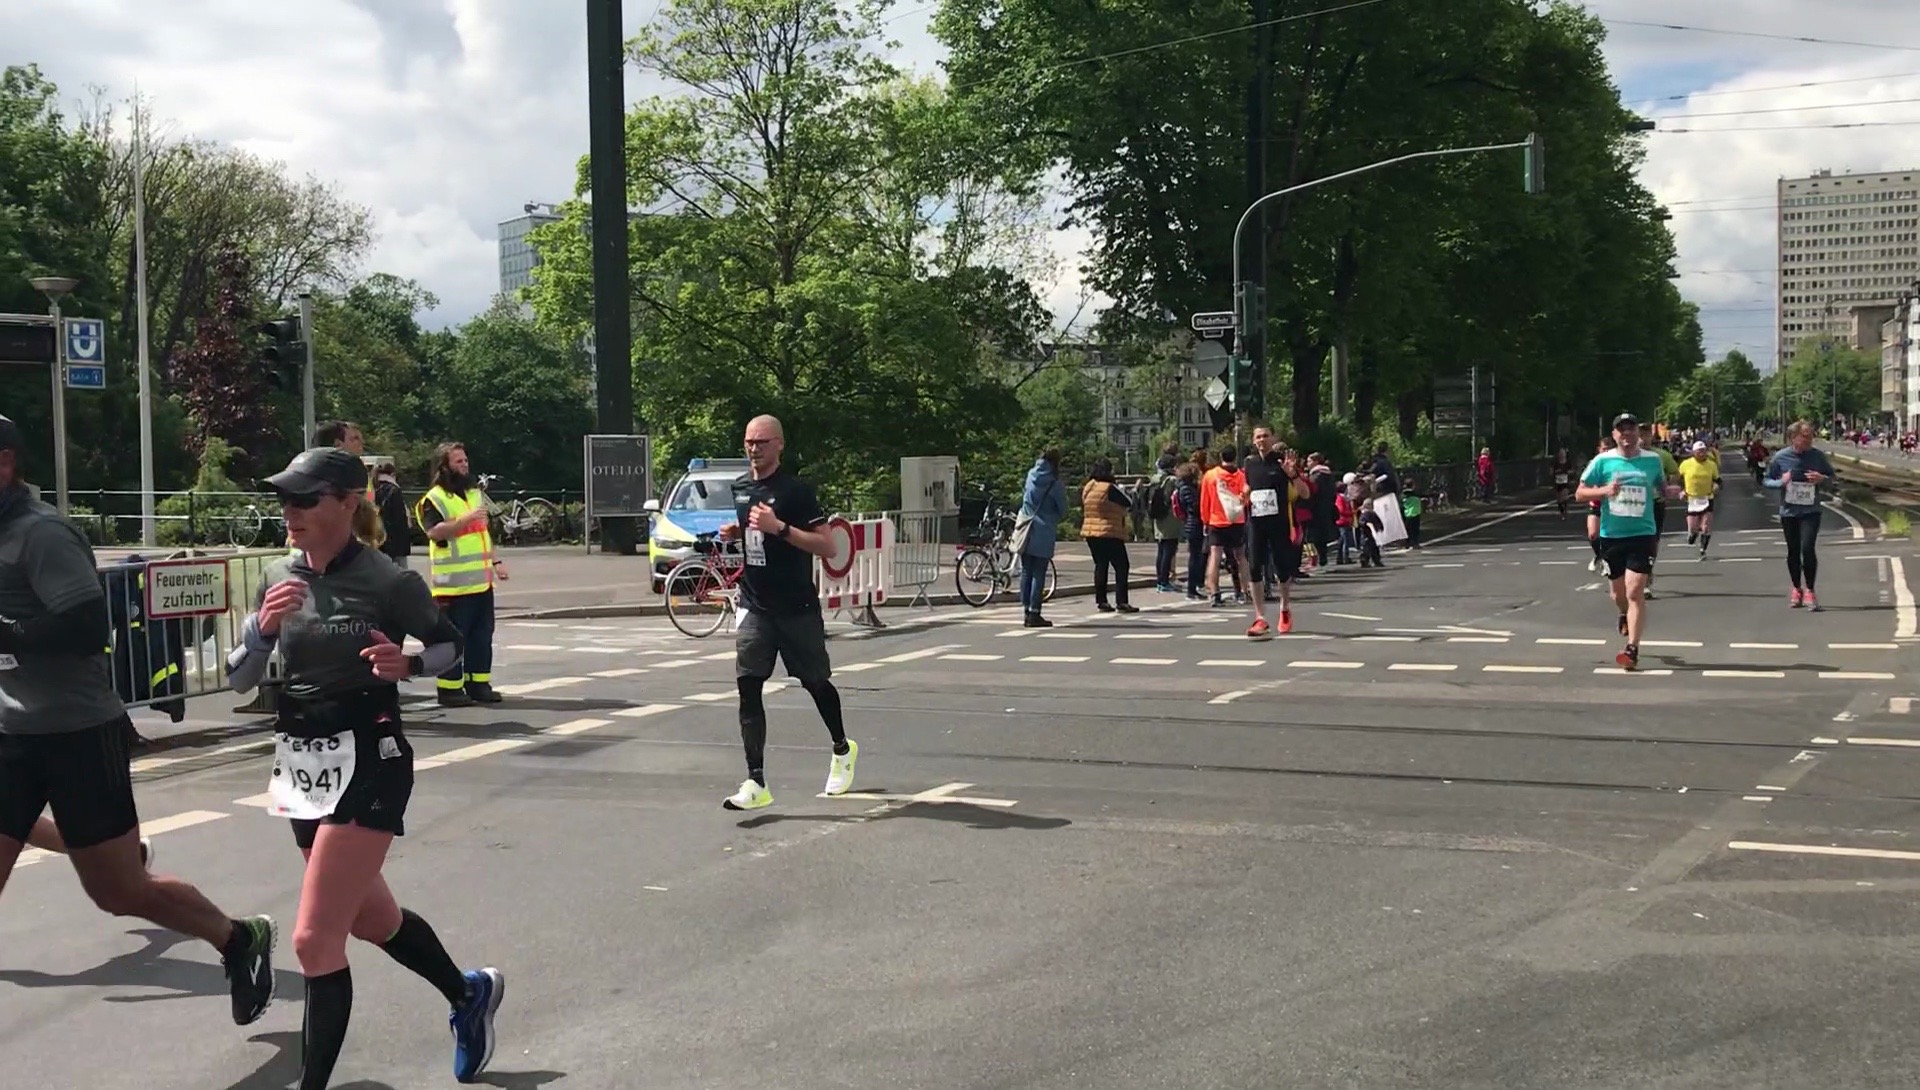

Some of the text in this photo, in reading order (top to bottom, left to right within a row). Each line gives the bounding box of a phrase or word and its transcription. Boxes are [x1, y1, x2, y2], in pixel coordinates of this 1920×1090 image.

[593, 465, 645, 476] OTELLO
[156, 568, 219, 588] Feuerwehr-
[163, 590, 214, 609] zufahrt
[289, 766, 342, 793] 1941
